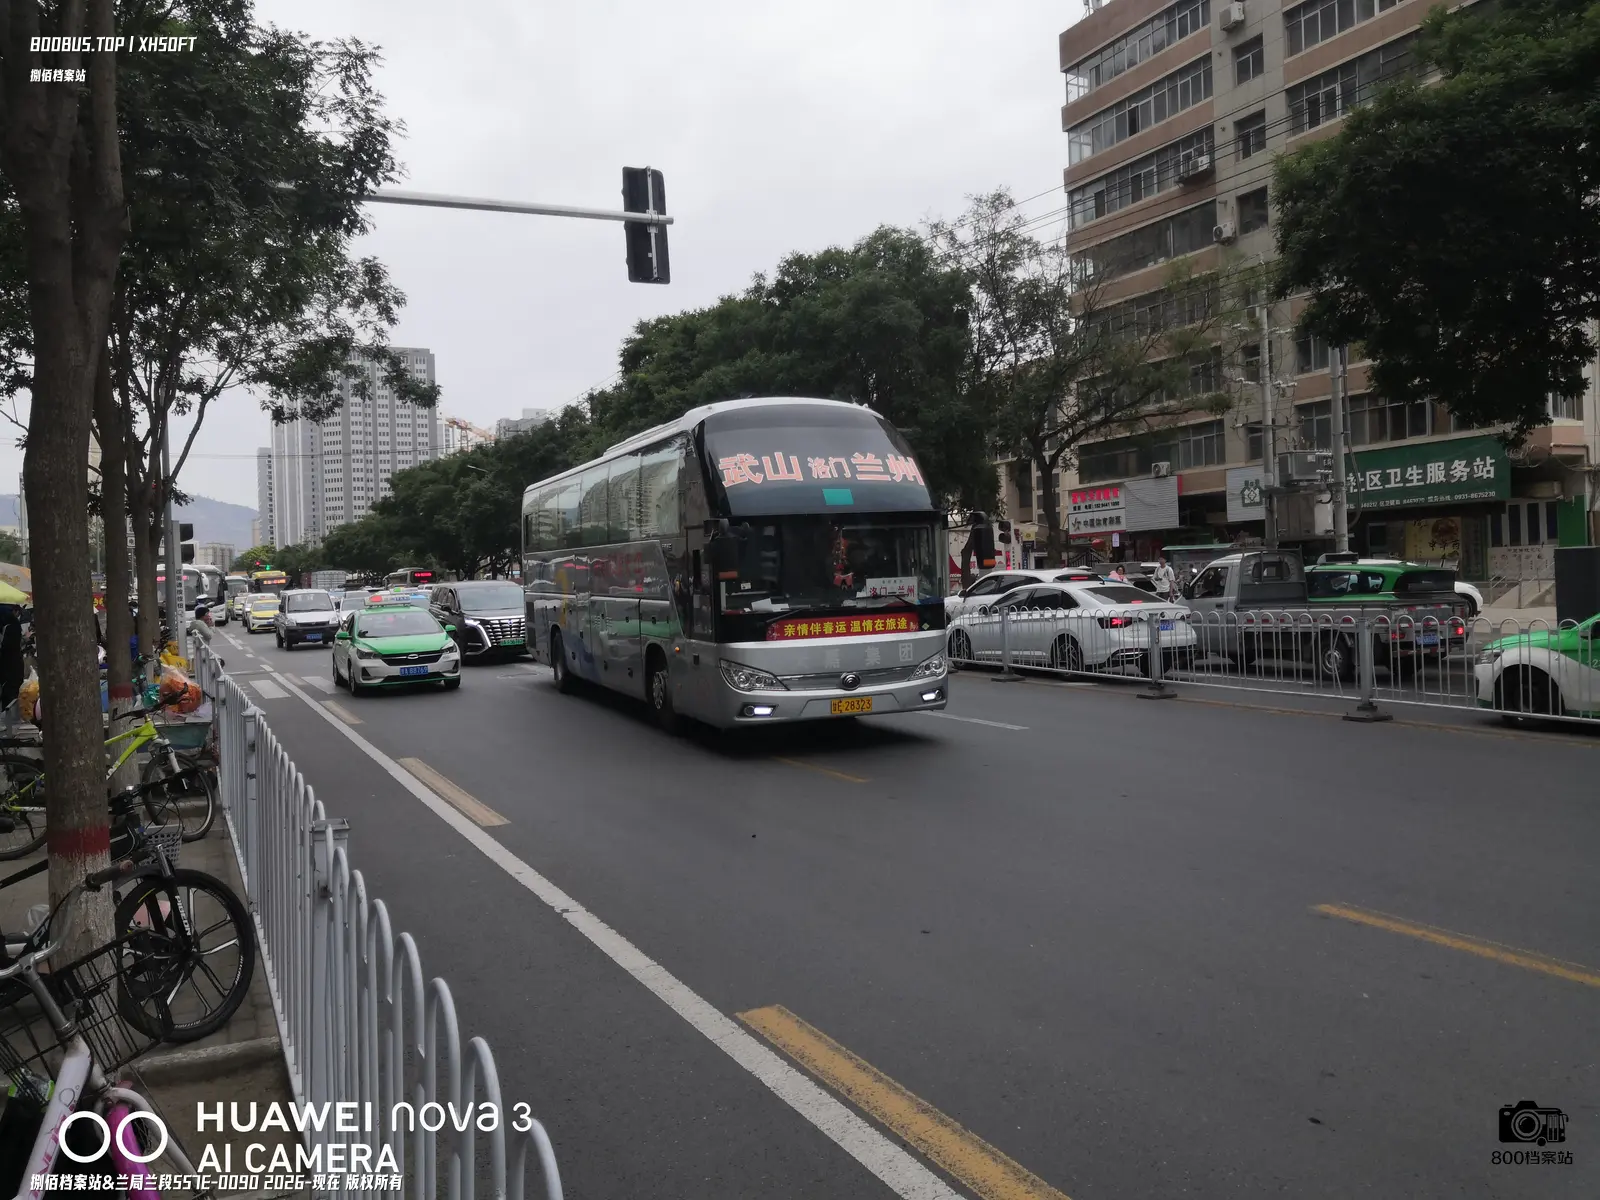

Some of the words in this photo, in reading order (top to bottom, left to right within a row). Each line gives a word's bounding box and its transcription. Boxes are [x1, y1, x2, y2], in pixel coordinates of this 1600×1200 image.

[1346, 456, 1496, 493] 社区卫生服务站
[783, 621, 847, 637] 亲情伴春运
[850, 617, 908, 633] 温情在旅途
